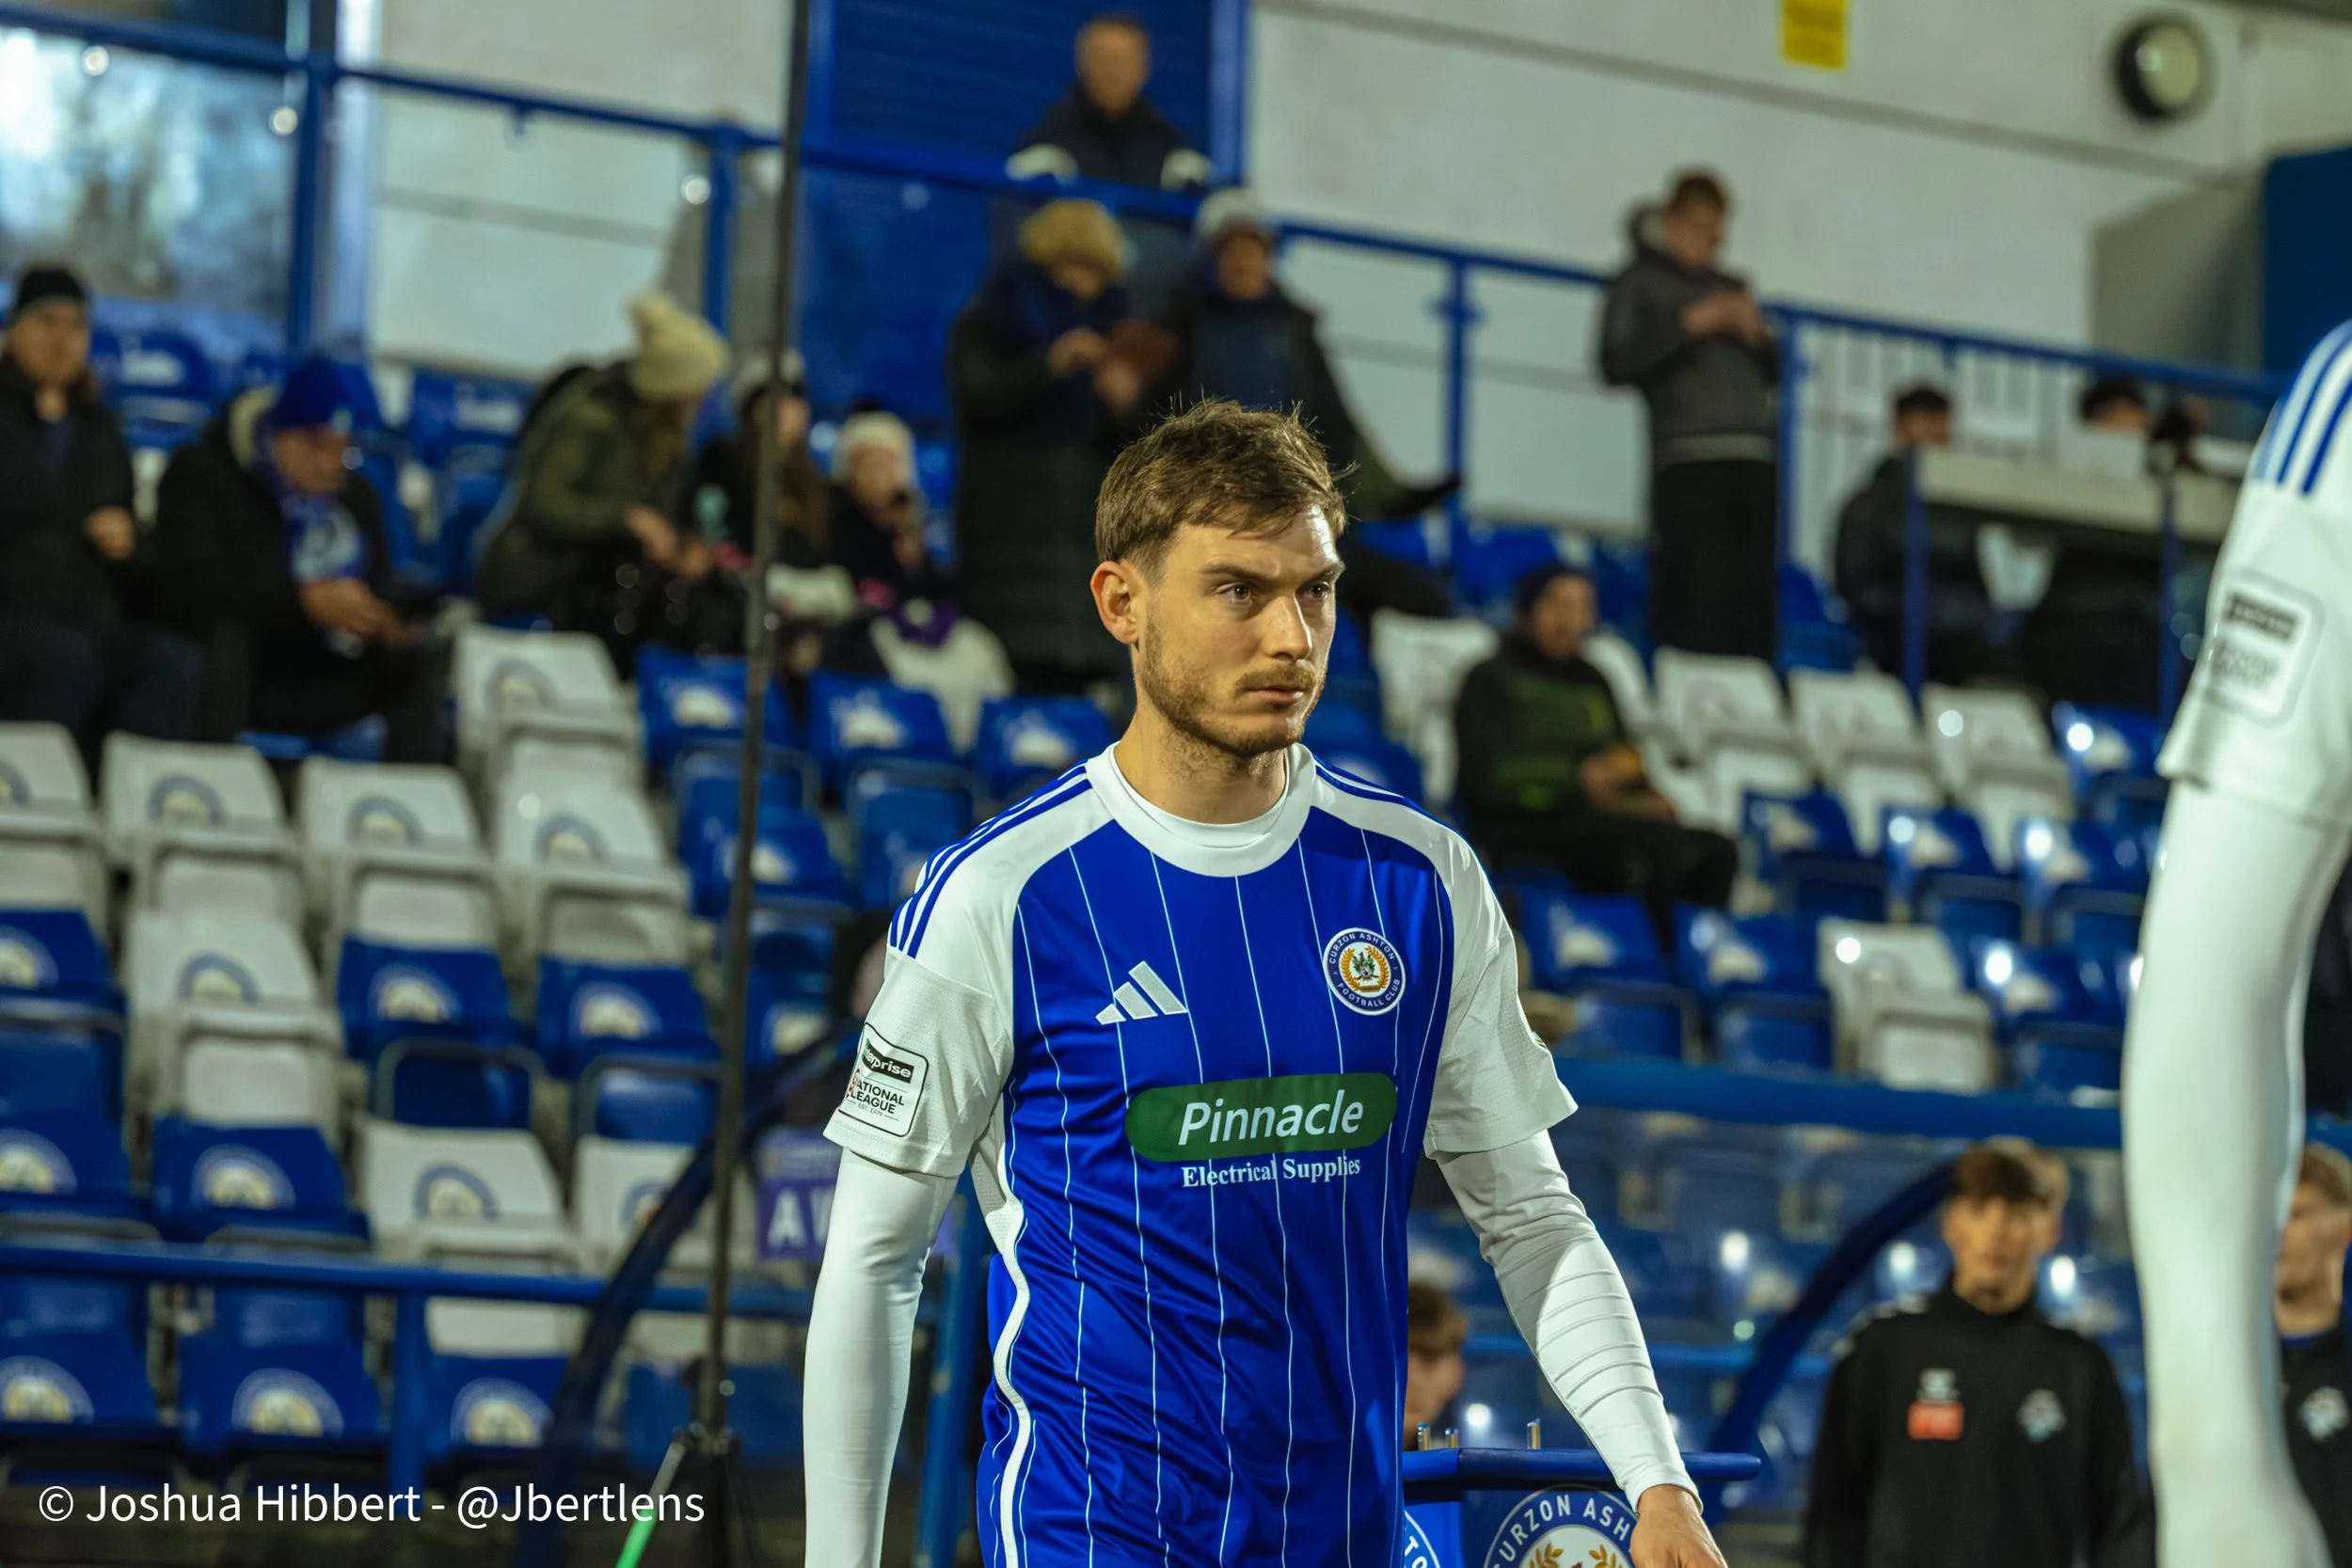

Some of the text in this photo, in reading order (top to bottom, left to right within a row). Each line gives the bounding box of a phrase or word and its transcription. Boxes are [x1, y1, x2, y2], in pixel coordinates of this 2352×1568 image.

[1328, 932, 1395, 964] CURZON ASHTON
[1337, 978, 1400, 1007] FOOTBALL CLUB
[850, 1090, 896, 1115] LEAGUE
[856, 1080, 904, 1106] ATIONAL
[1177, 1089, 1364, 1146] Pinnacle
[1182, 1155, 1361, 1187] Electrical Supplies
[1492, 1494, 1571, 1568] URZON
